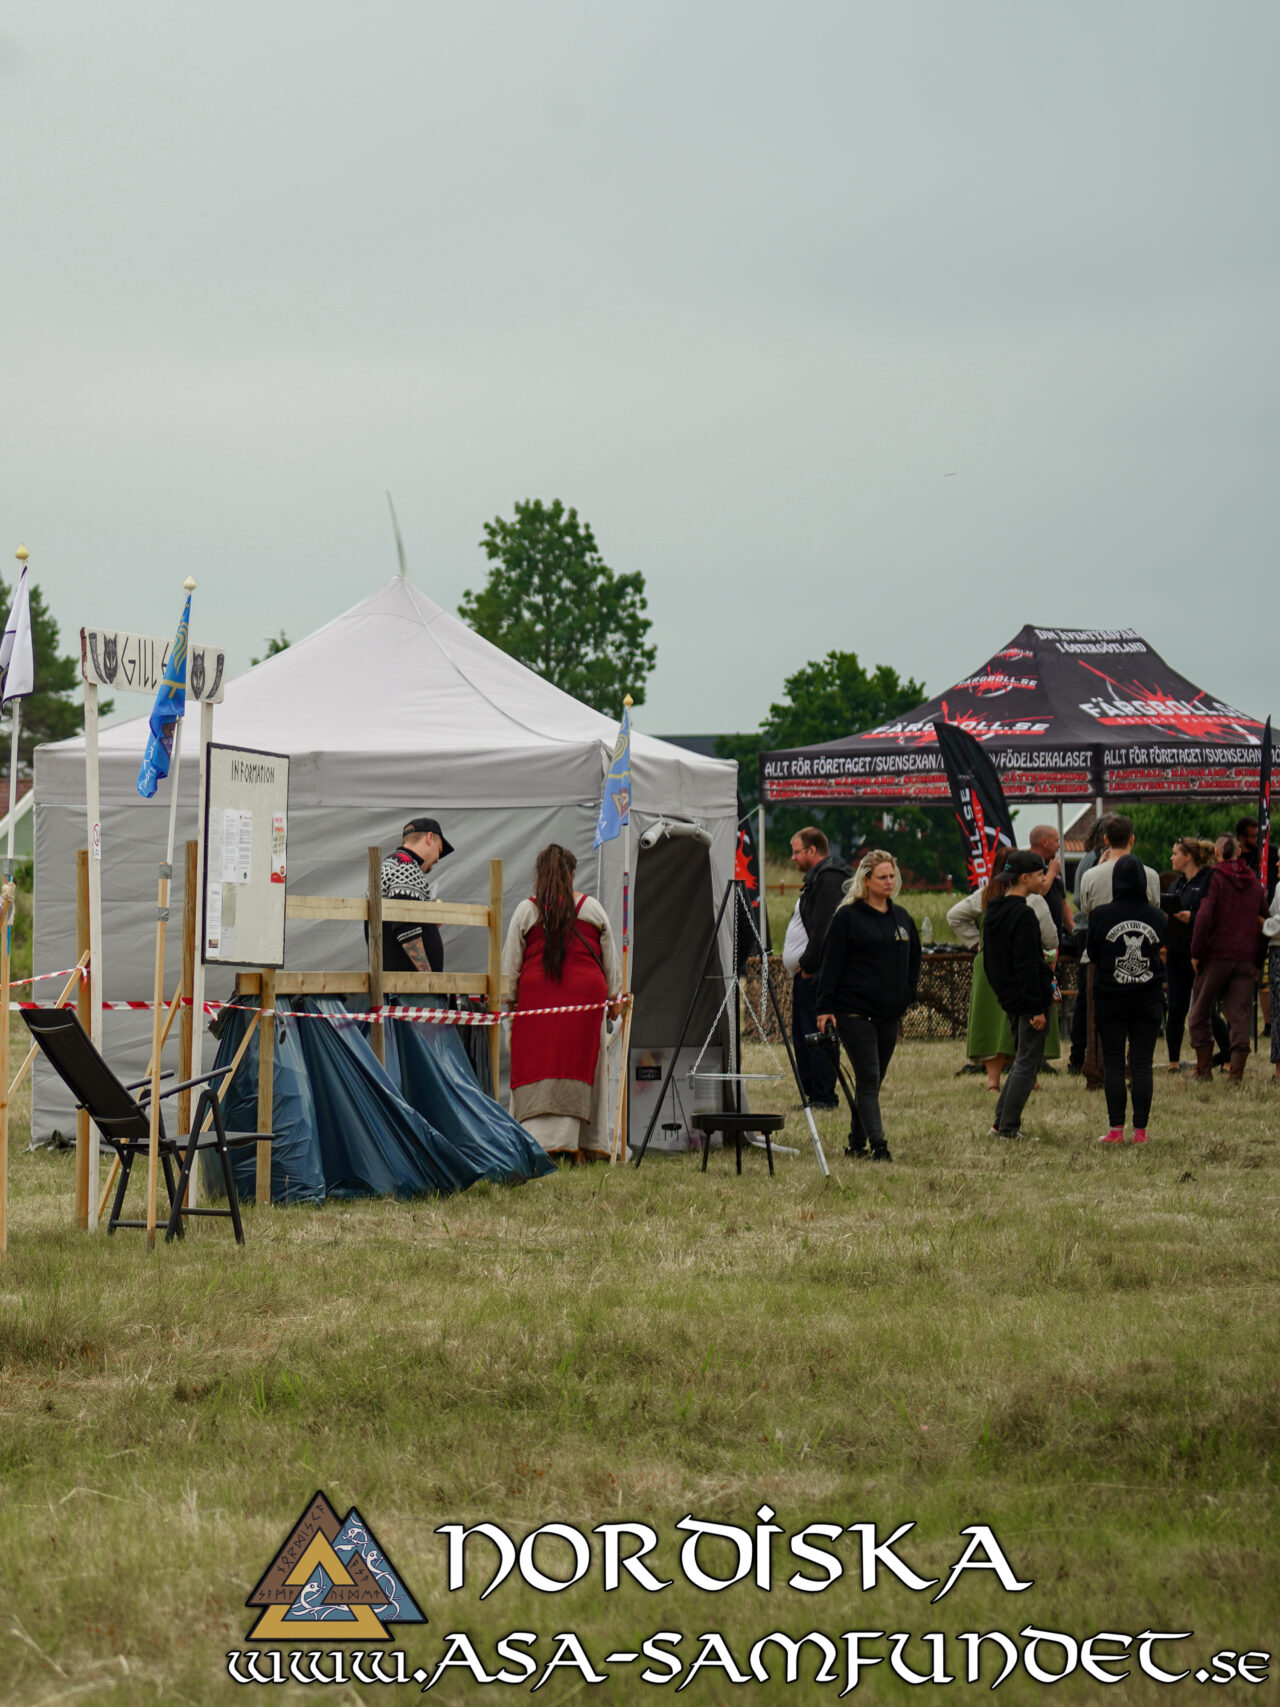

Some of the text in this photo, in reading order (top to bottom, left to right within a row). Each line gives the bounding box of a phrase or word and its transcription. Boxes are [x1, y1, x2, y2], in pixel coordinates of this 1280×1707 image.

[871, 721, 1050, 735] FÄRGOLL.SE
[1104, 749, 1127, 765] ALLT
[1129, 746, 1148, 764] FÖR
[231, 760, 275, 784] INFORMATION
[765, 760, 789, 777] ALLT
[791, 756, 811, 776] FÖR
